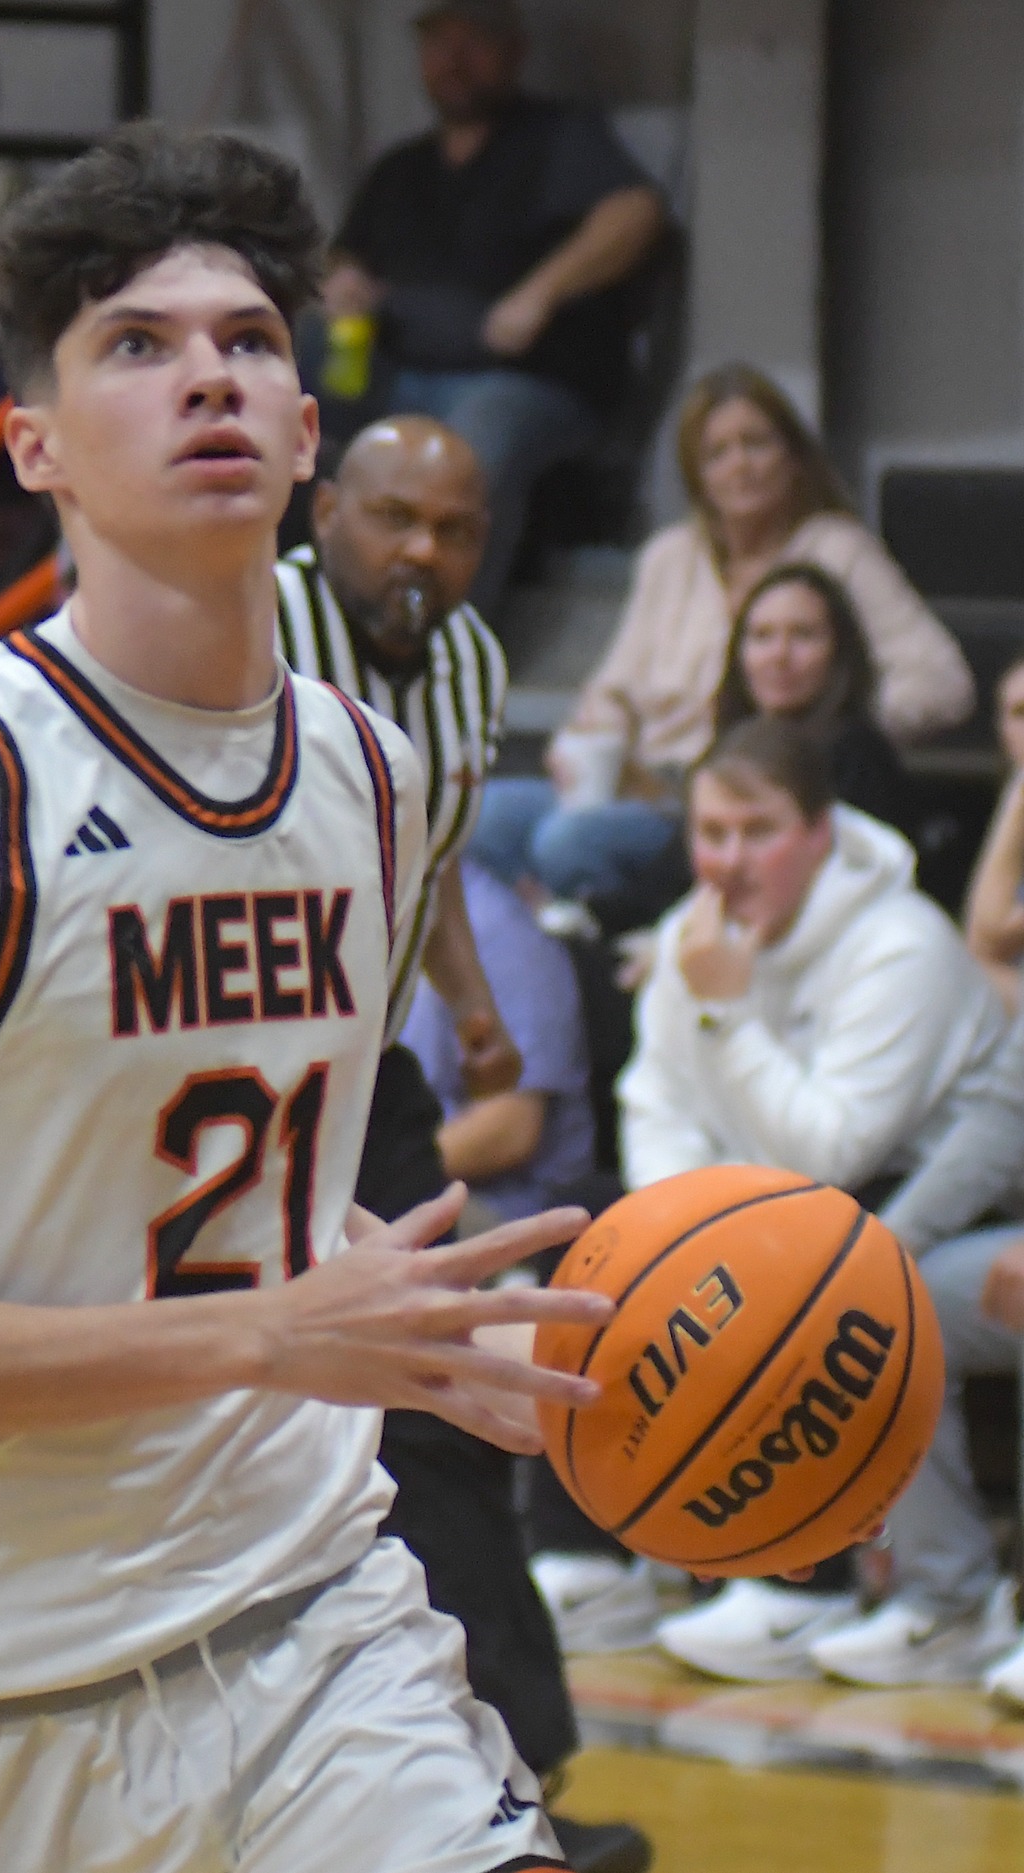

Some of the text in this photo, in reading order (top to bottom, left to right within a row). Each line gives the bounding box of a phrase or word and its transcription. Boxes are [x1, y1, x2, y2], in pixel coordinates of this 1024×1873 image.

[107, 888, 358, 1039] MEEK
[144, 1060, 330, 1301] 21
[682, 1308, 897, 1528] Wilson
